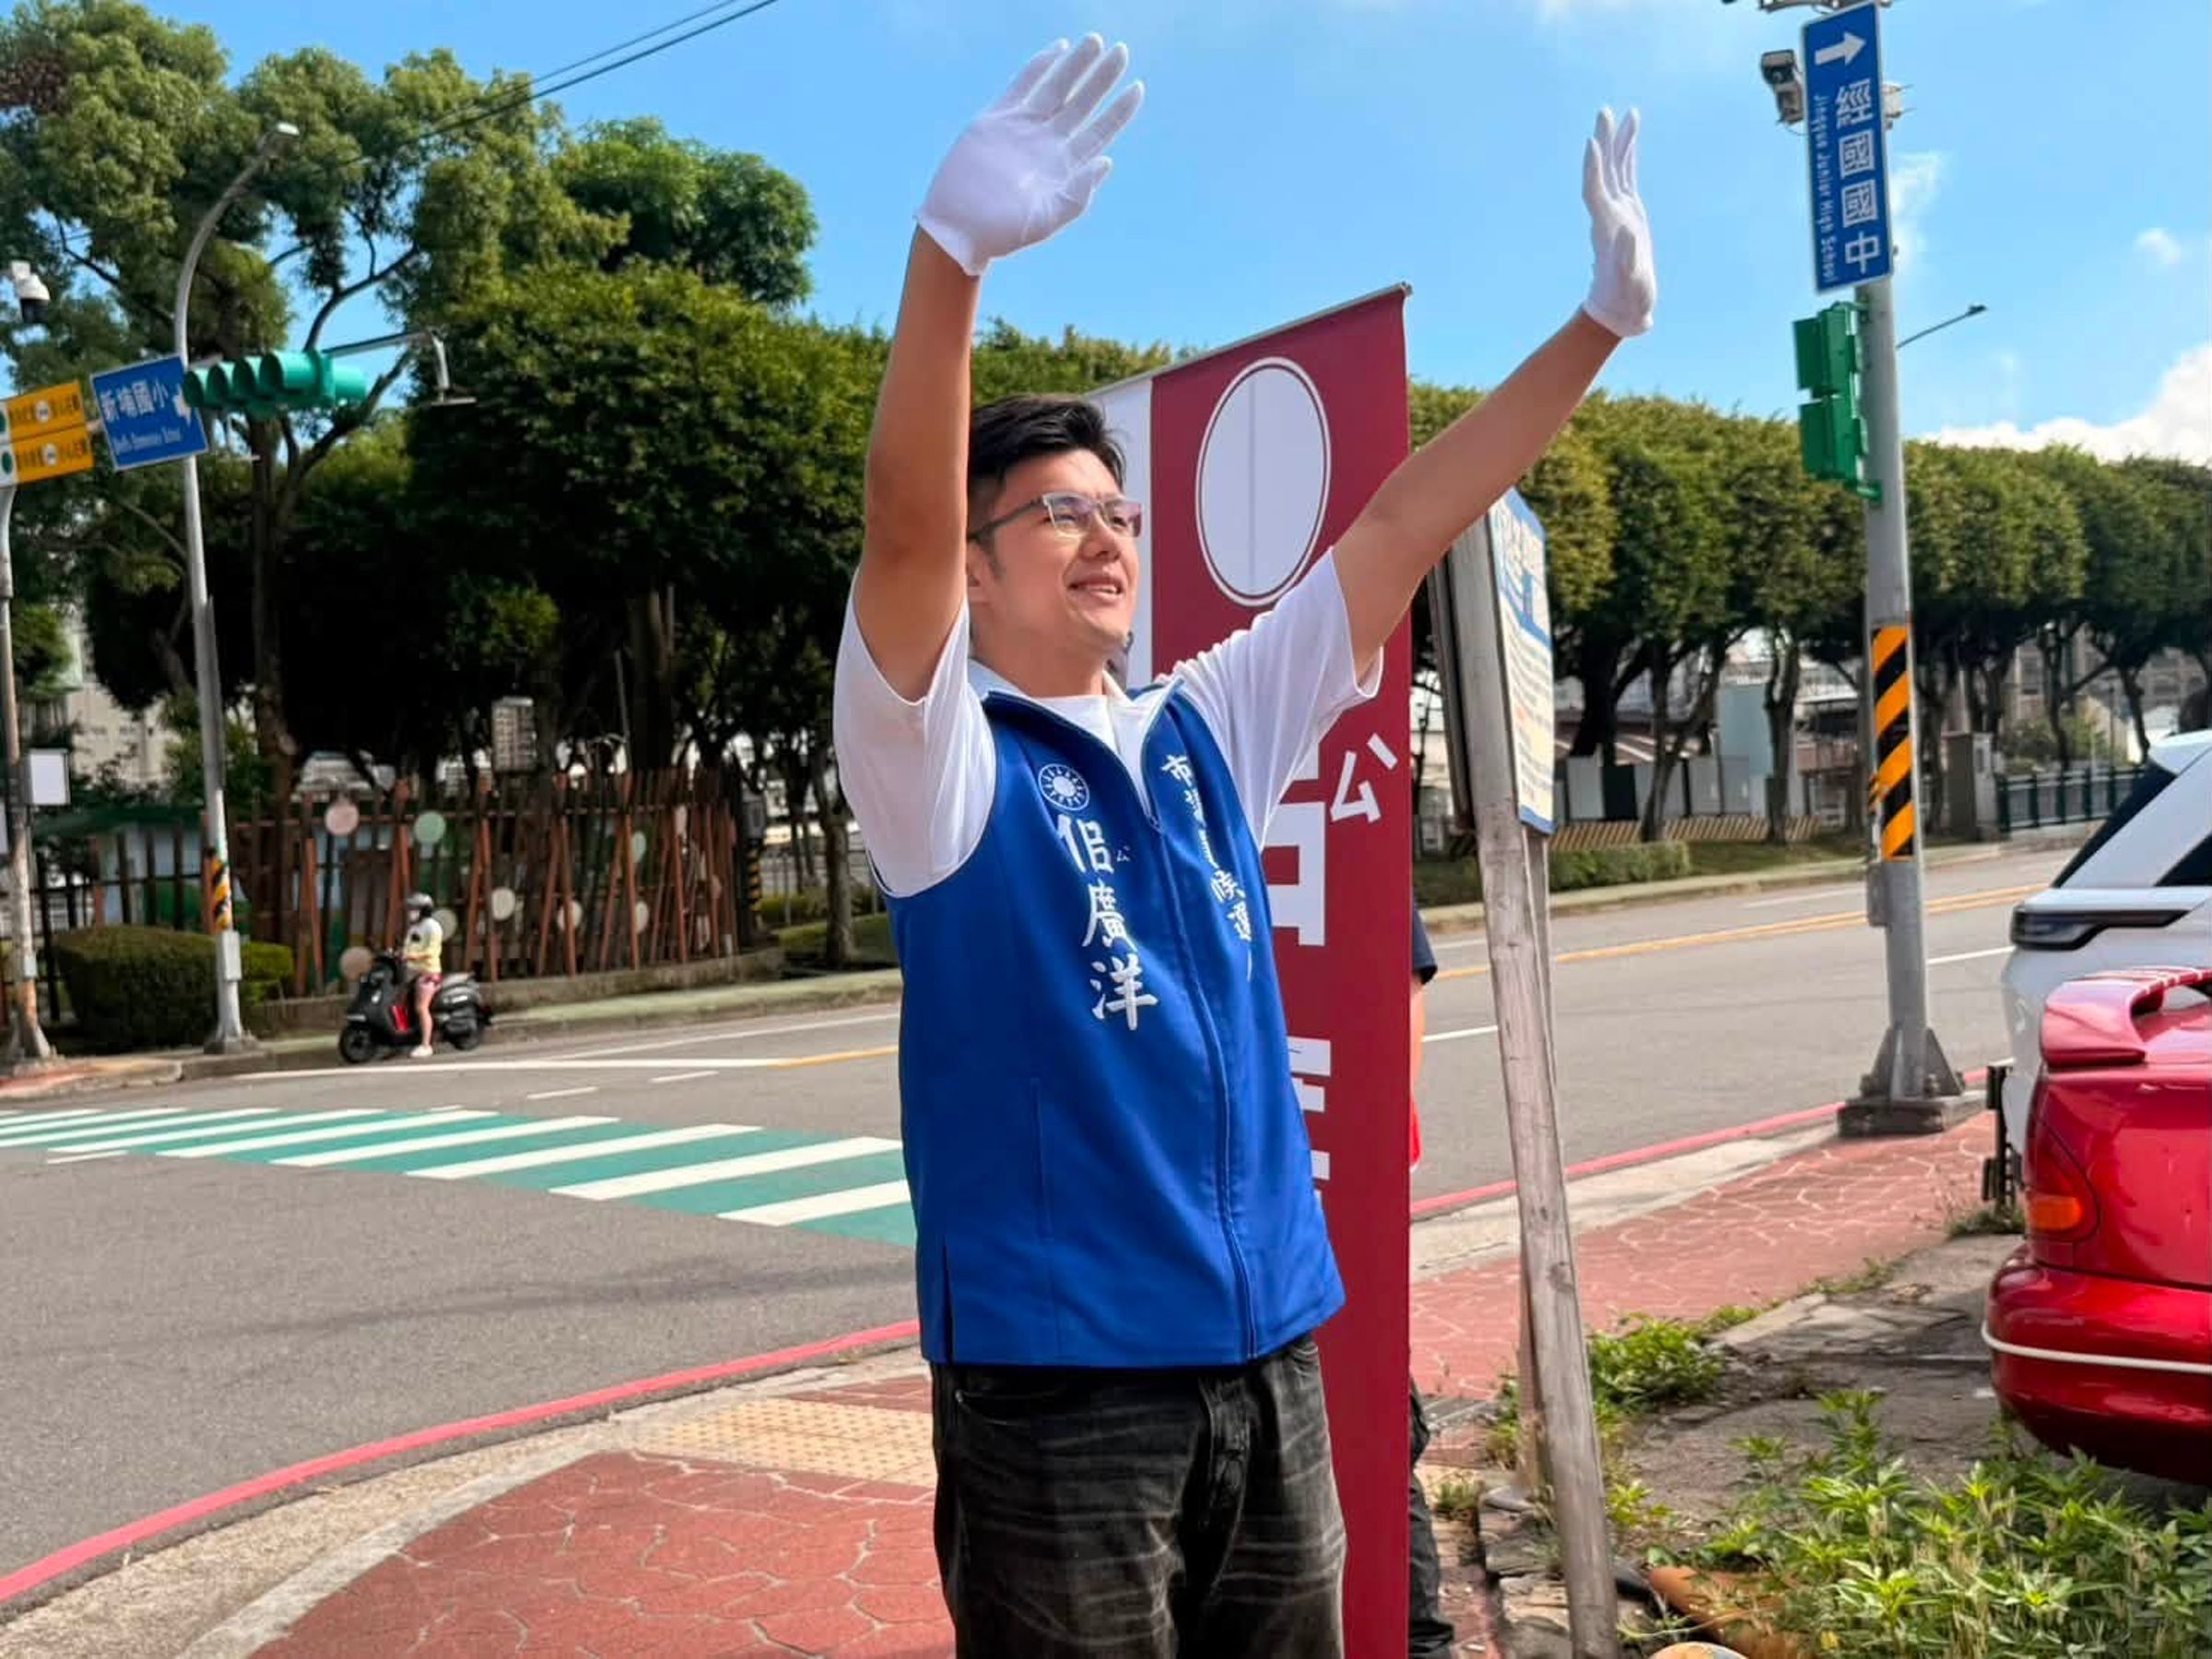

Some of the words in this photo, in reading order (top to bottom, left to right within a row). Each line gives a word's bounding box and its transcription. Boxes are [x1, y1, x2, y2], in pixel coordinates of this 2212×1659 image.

[1815, 152, 1832, 197] Junior
[1835, 78, 1879, 274] 經國國中
[1818, 200, 1834, 233] High
[1820, 235, 1835, 283] School
